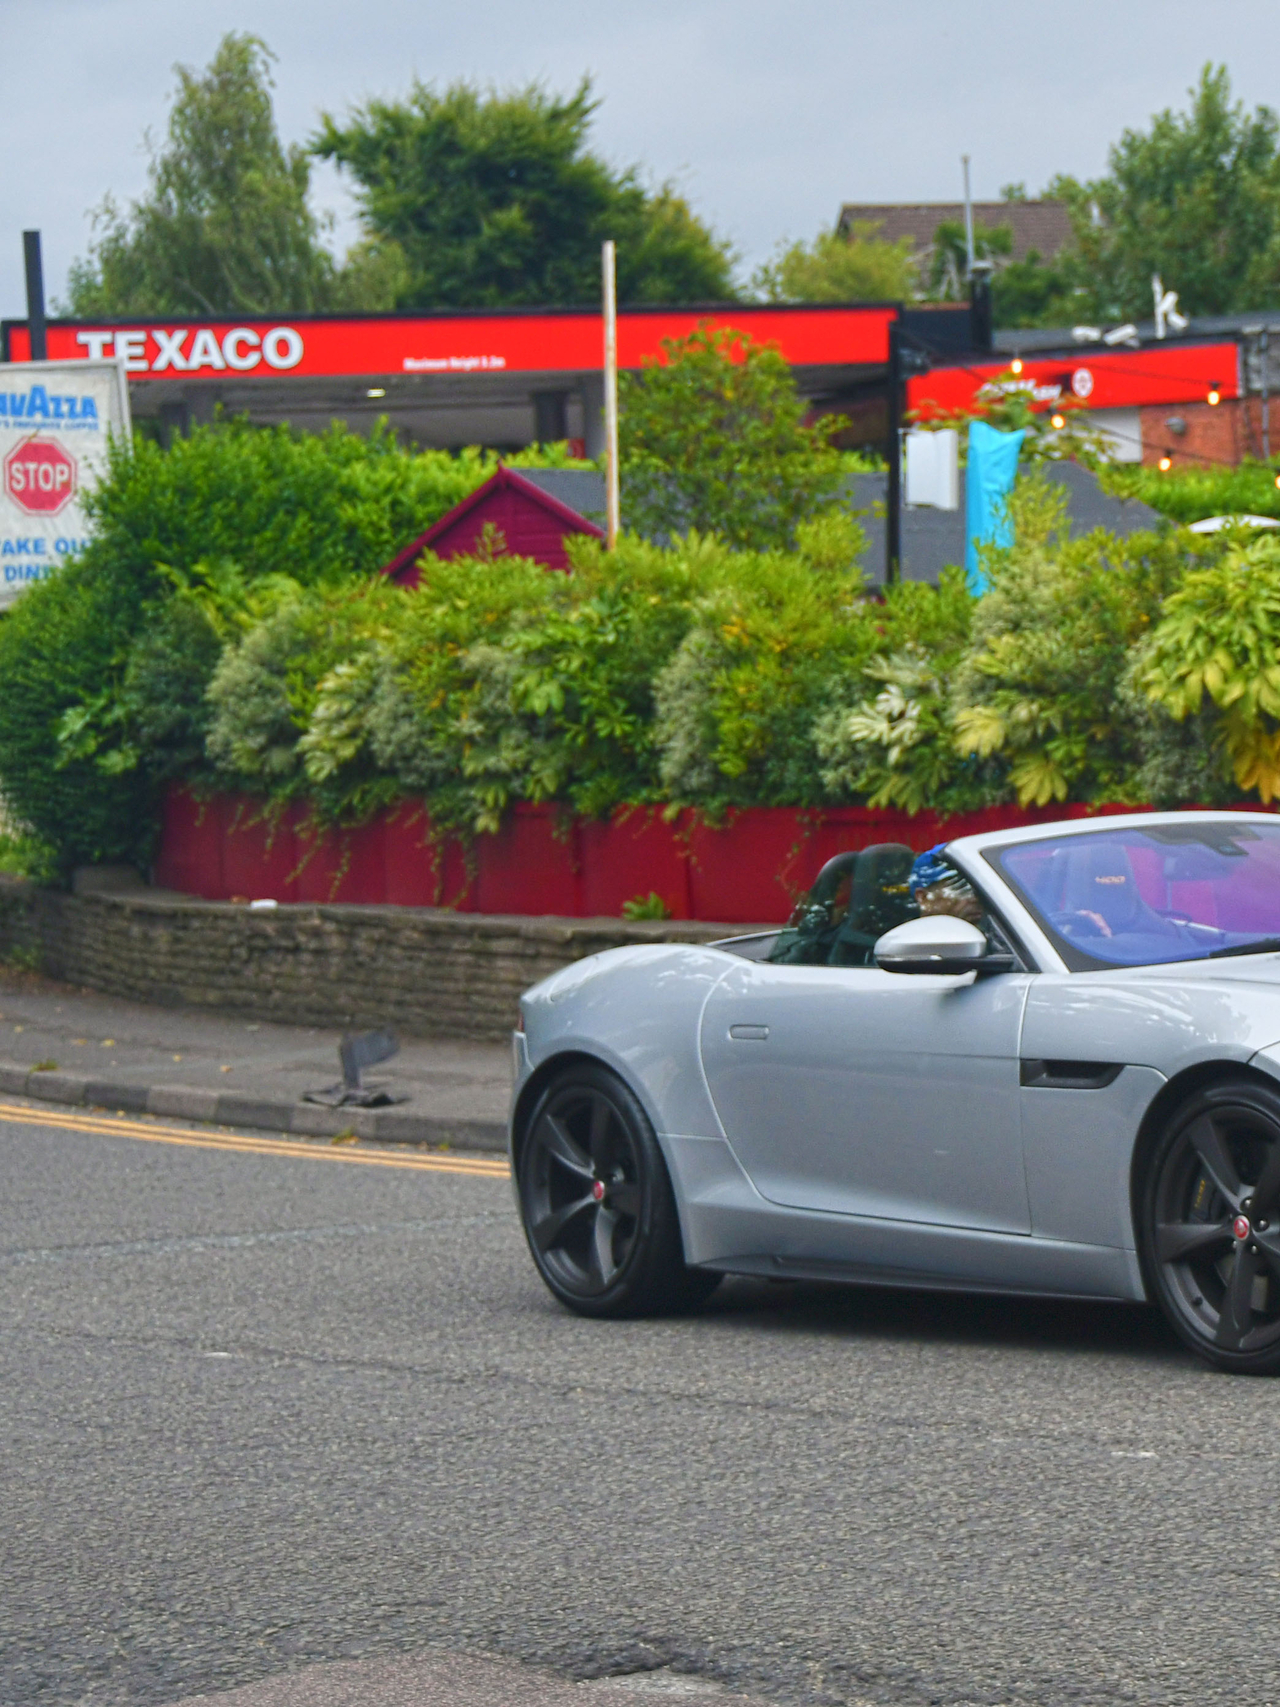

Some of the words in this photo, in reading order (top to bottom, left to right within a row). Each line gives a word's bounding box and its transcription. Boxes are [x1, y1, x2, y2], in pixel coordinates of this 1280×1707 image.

[77, 326, 304, 371] TEXACO
[11, 462, 70, 491] STOP
[0, 537, 46, 556] AKE
[55, 536, 92, 555] OU
